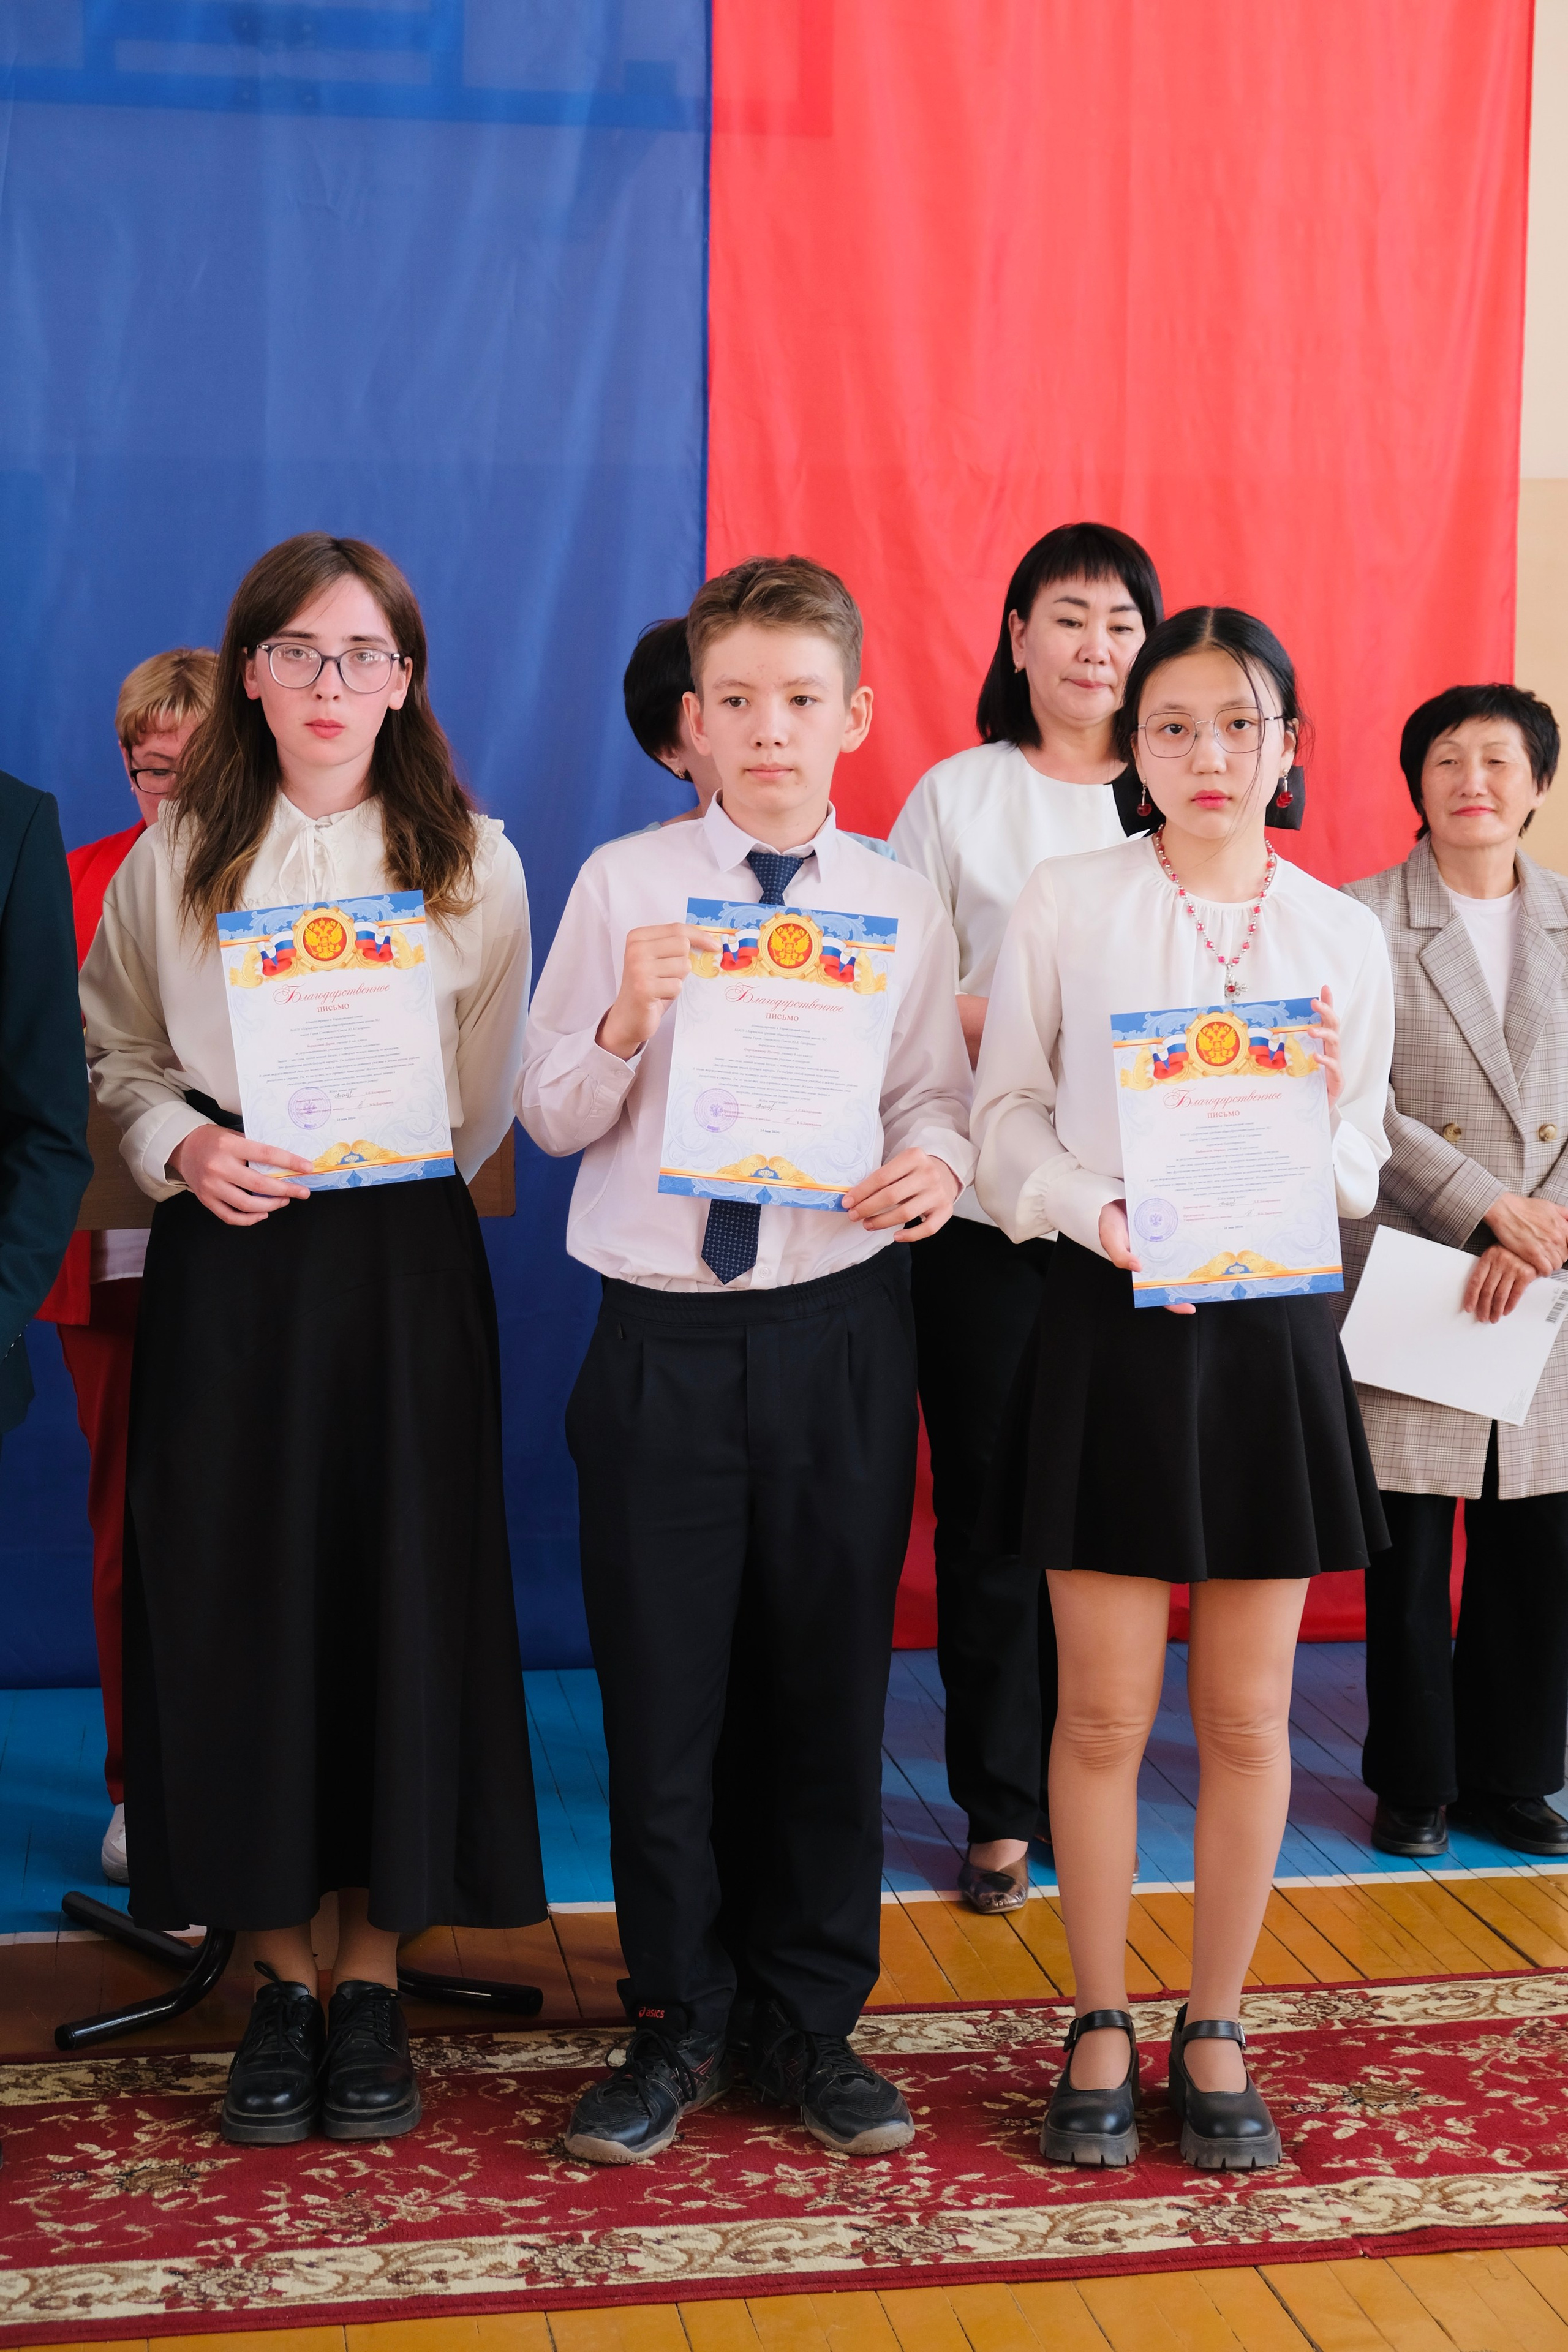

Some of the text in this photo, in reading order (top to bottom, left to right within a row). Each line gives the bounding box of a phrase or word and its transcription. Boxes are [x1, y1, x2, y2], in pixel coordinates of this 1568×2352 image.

[273, 983, 390, 1005] Благодарственное
[724, 982, 845, 1012] Благодарственное
[1163, 1088, 1283, 1110] Благодарственное
